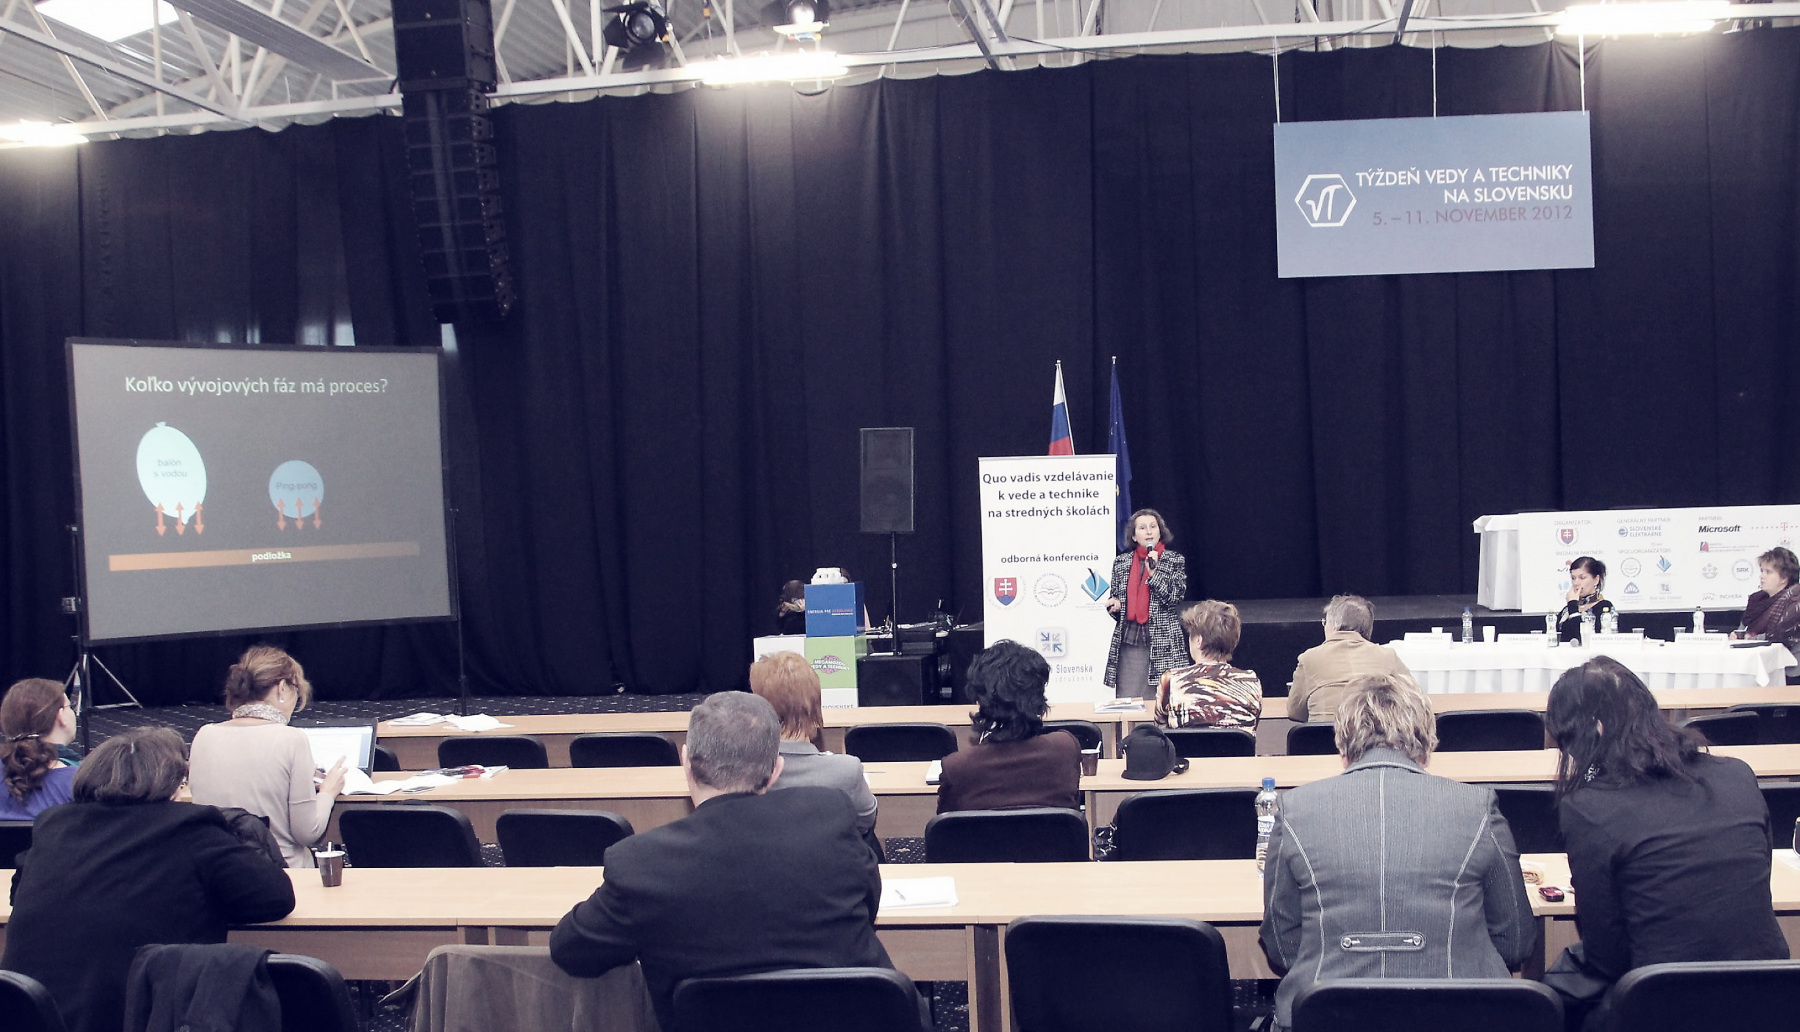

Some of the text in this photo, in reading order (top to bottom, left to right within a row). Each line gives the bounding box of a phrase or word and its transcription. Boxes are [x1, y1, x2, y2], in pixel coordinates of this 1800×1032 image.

[1355, 164, 1573, 186] TÝŽDEŇ VEDY A TECHNIKY
[1444, 184, 1573, 204] NA SLOVENSKU
[1435, 206, 1527, 223] NOVEMBER
[1532, 204, 1573, 221] 2012
[124, 376, 388, 396] Koľko vývojových fáz má proces?
[982, 470, 1114, 484] Quo vadis vzdelávanie
[998, 490, 1006, 500] k
[1008, 490, 1037, 500] vede
[1048, 489, 1100, 499] technike
[988, 505, 1110, 519] na stredných školách
[1698, 524, 1740, 533] Microsoft
[251, 550, 292, 562] podložka
[1001, 552, 1099, 564] odborná konferencia
[1056, 663, 1093, 674] Slovenska
